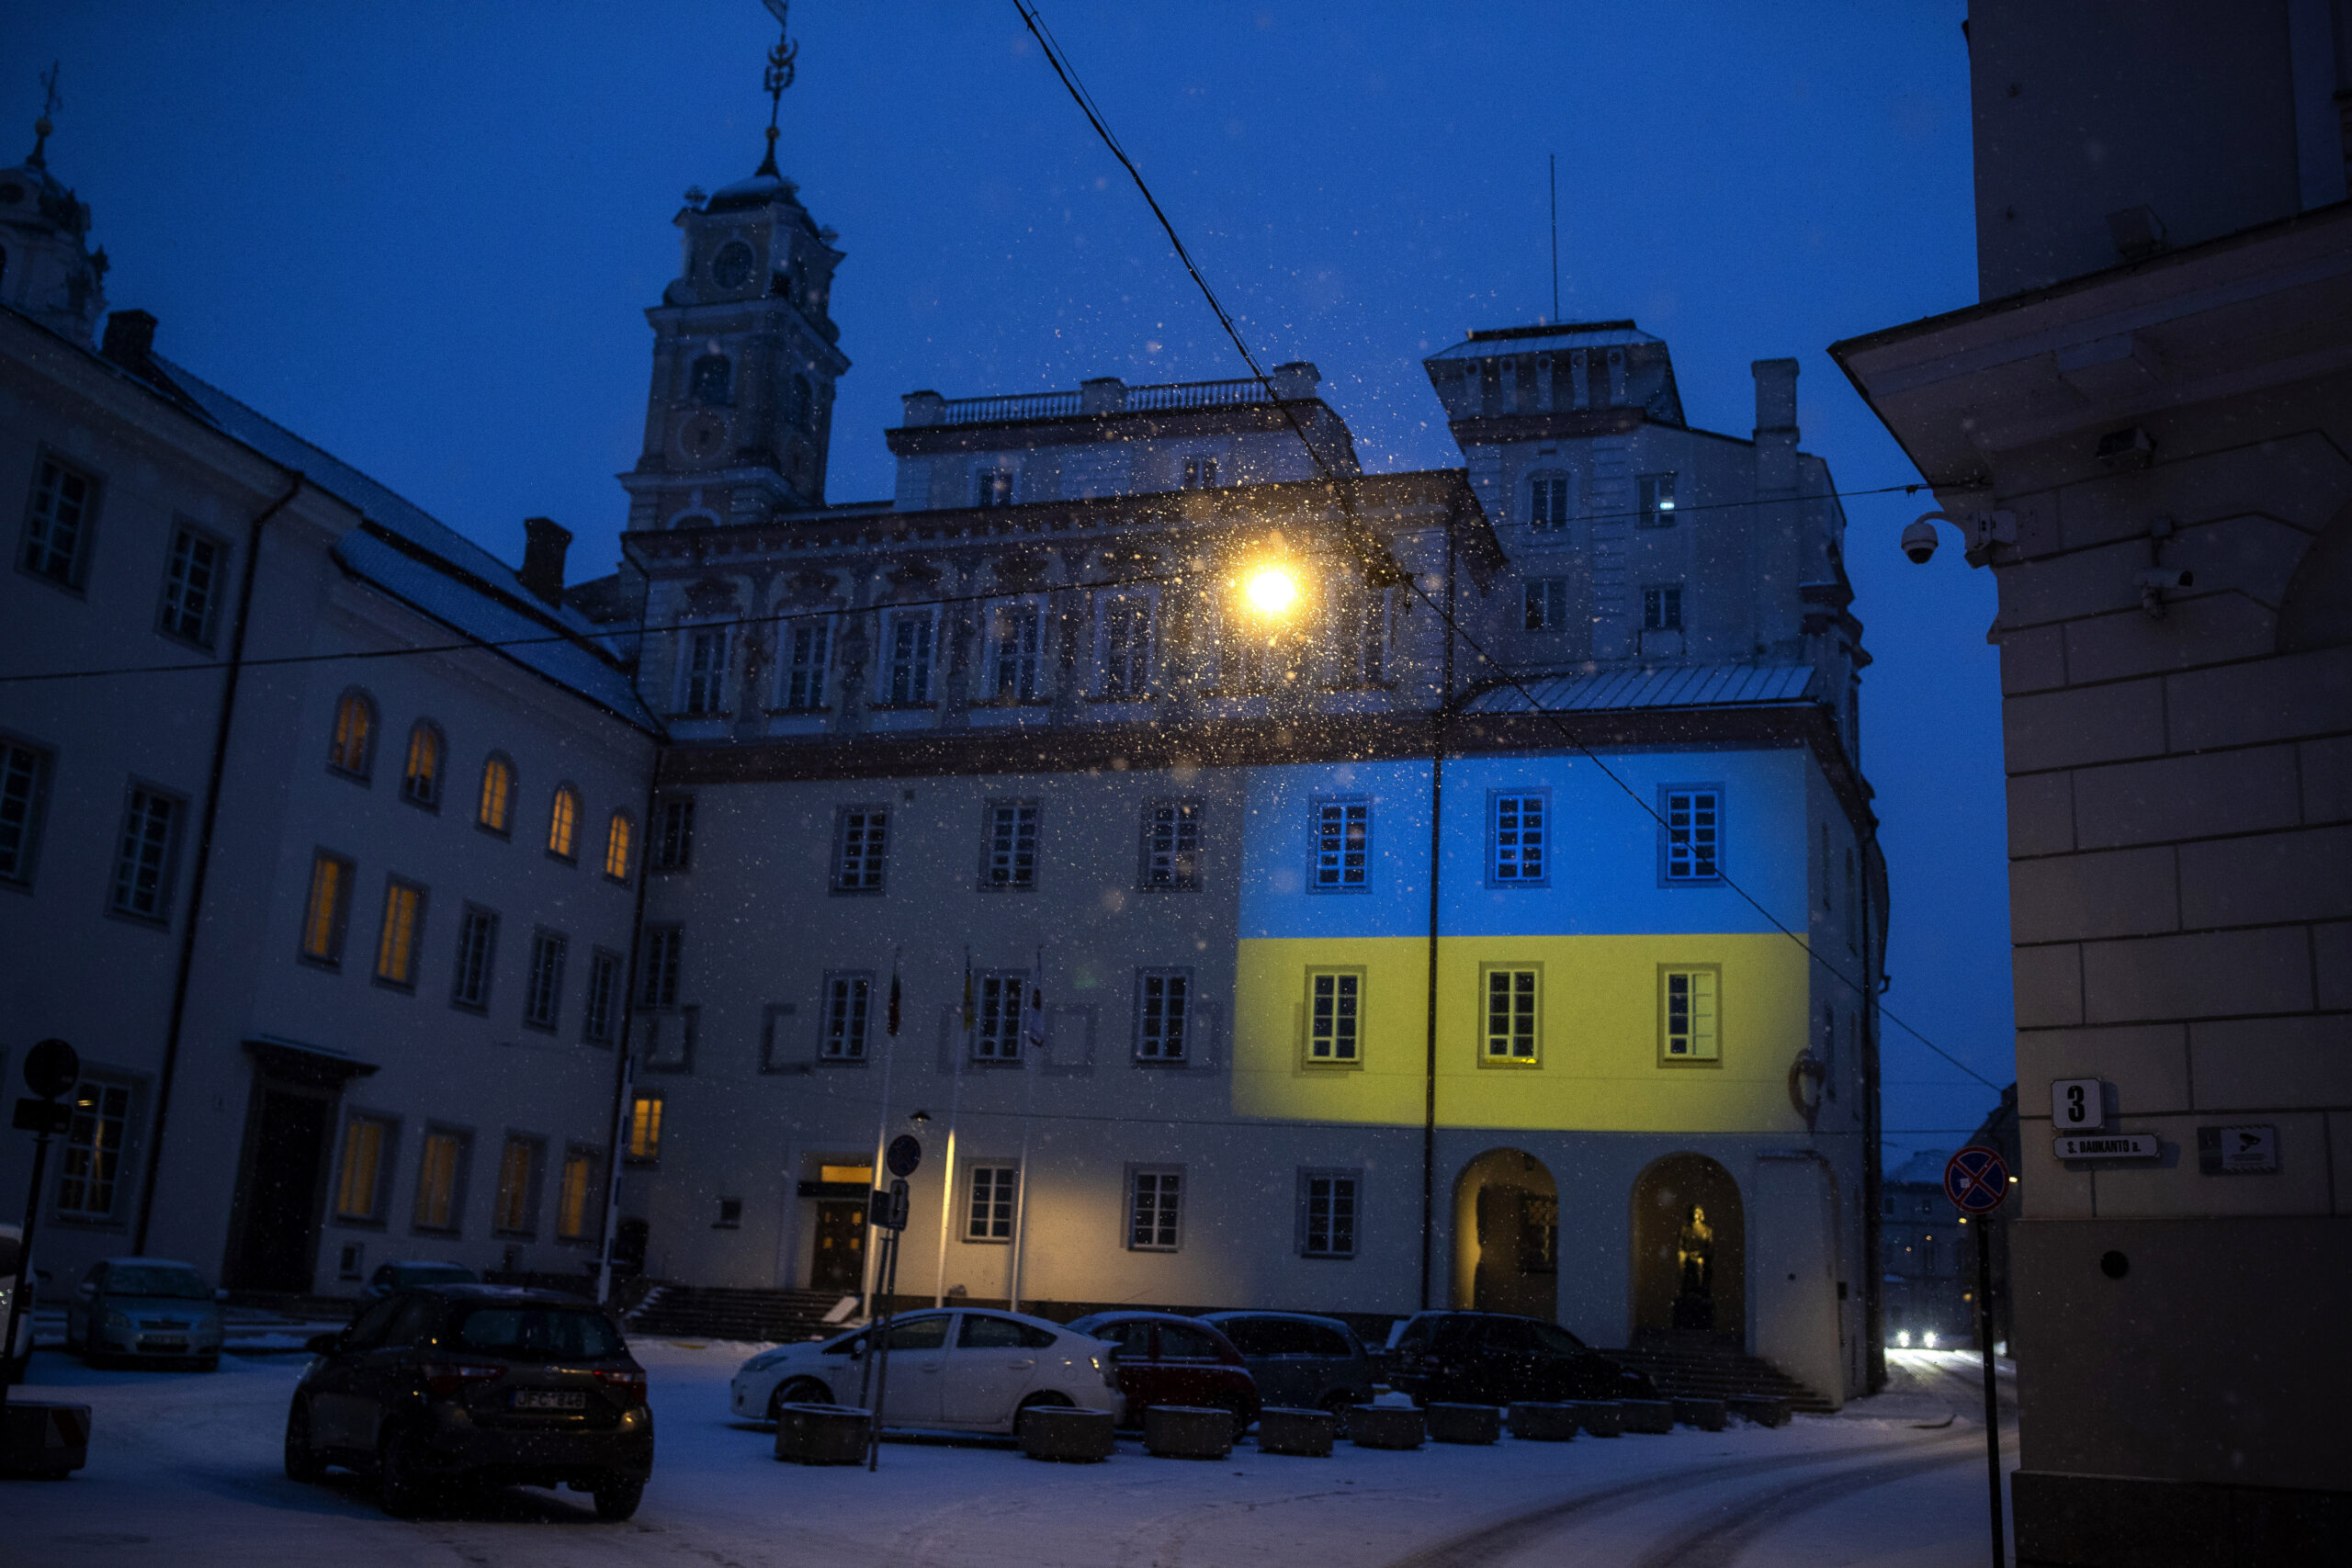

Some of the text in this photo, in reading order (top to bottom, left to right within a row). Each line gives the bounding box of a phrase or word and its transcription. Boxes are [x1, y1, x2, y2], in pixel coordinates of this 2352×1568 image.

[2067, 1085, 2085, 1122] 3
[2067, 1141, 2077, 1154] S.
[2079, 1139, 2130, 1154] DAUKANTO
